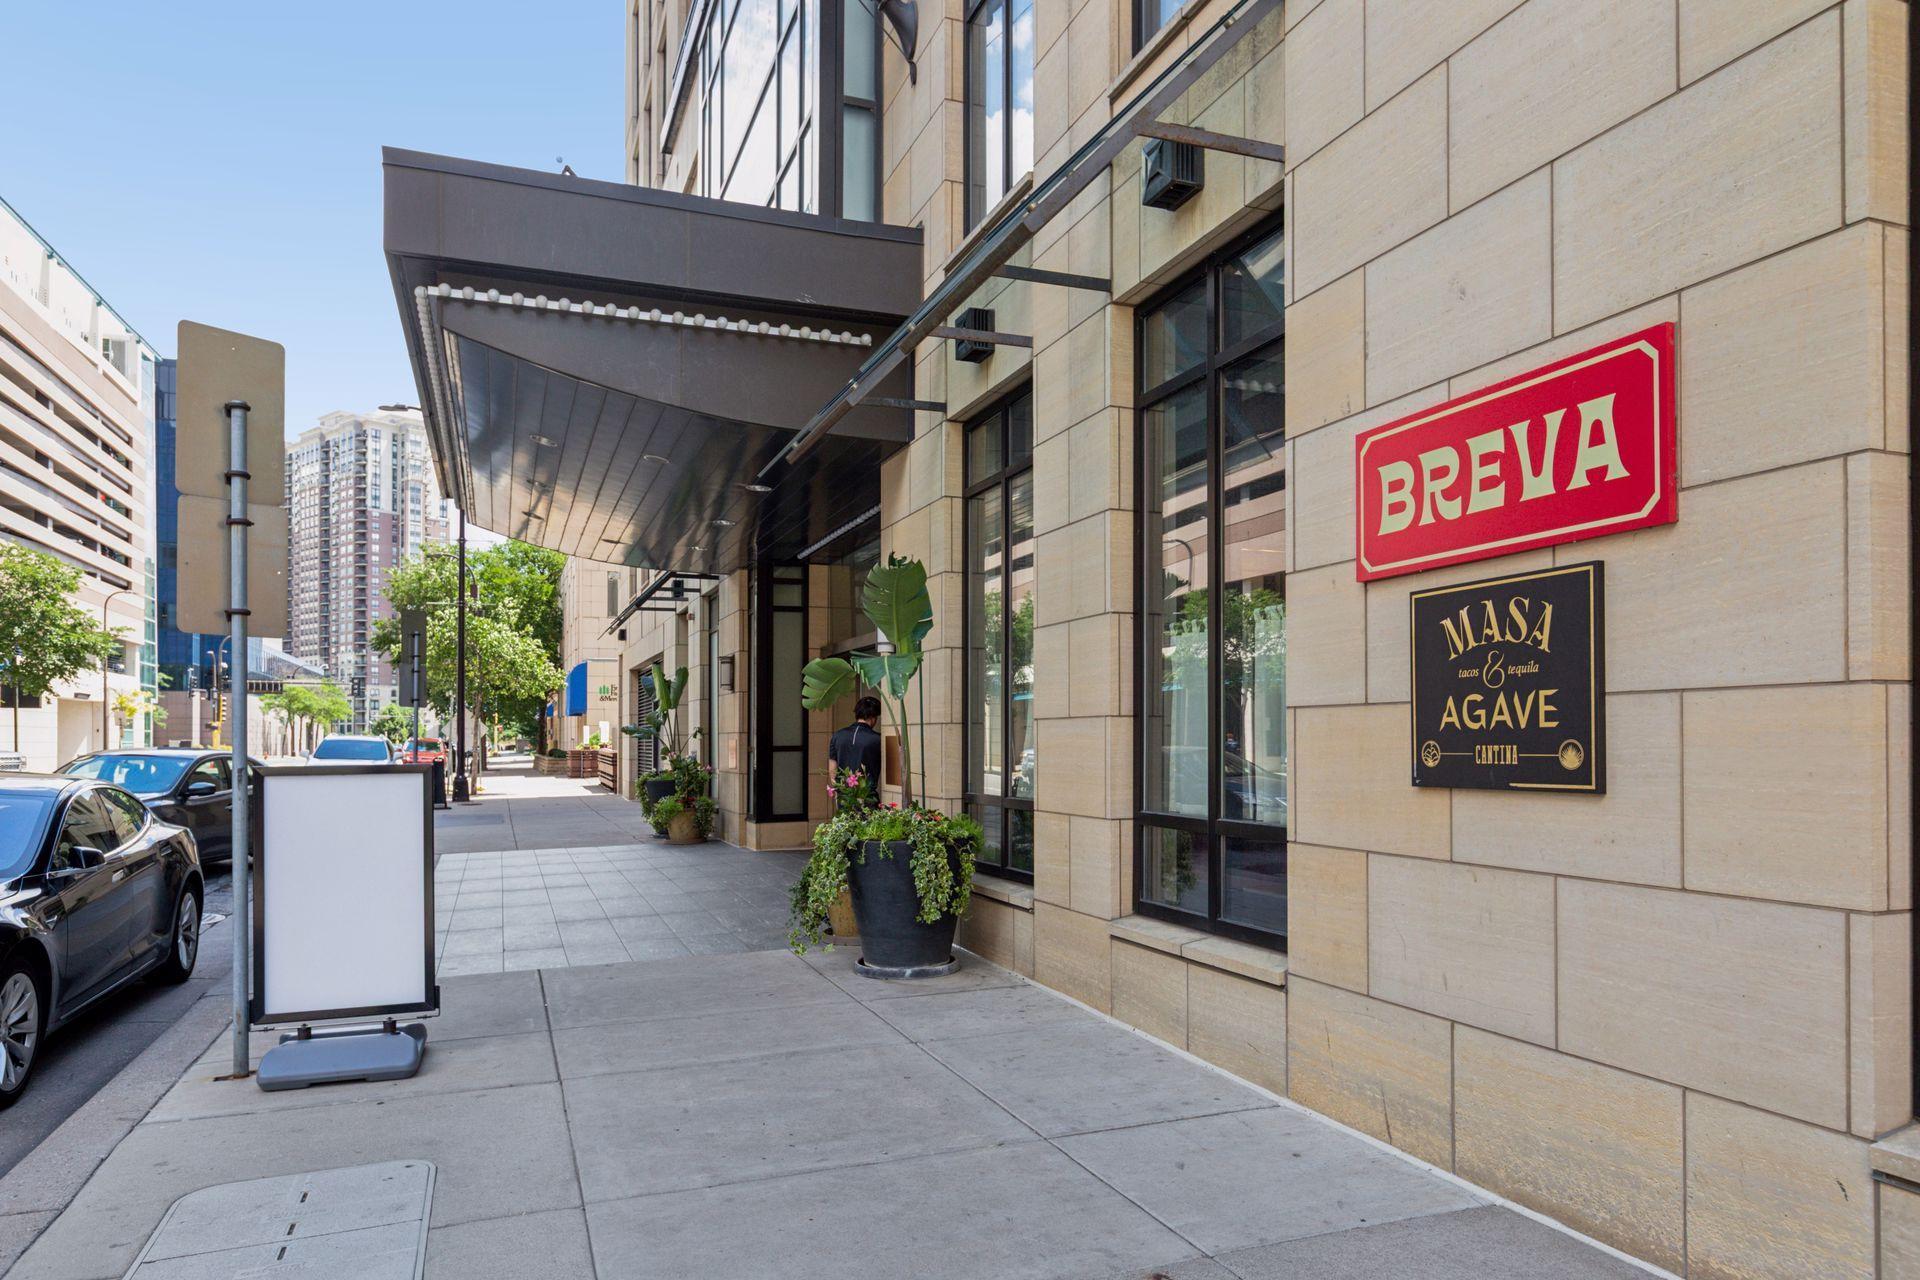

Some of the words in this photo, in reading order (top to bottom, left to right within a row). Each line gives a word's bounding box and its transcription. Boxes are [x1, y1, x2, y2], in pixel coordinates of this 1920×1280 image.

[1377, 392, 1631, 536] BREVA
[1439, 596, 1553, 661] MASA
[1458, 667, 1480, 679] tacos
[1482, 650, 1505, 689] &
[1507, 660, 1539, 678] tequila
[1439, 688, 1561, 732] AGAVE
[1475, 744, 1519, 765] CANTINA
